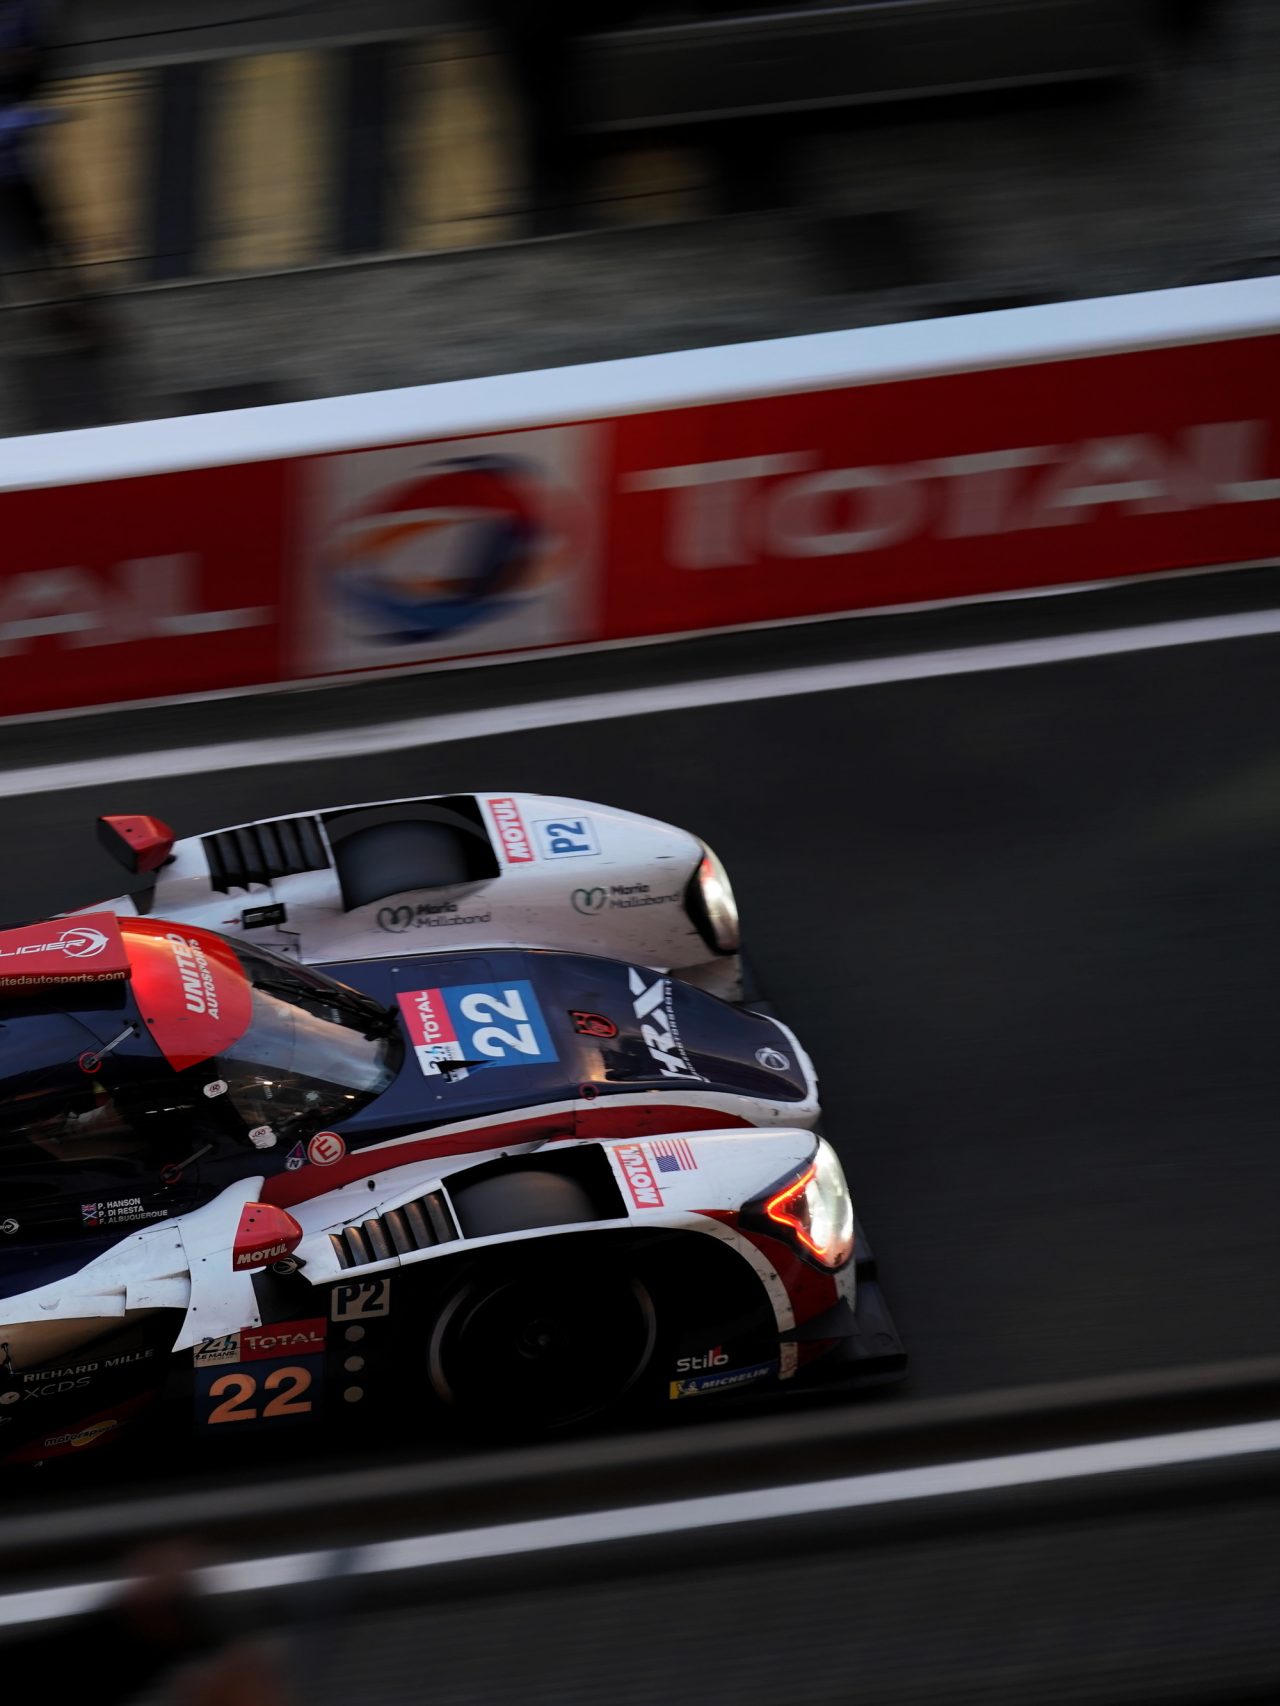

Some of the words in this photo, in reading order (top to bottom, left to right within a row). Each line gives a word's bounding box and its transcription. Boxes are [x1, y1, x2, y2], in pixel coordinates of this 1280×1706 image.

[619, 418, 1280, 570] TOTAL
[491, 799, 531, 862] MOTUL
[544, 821, 589, 854] P2
[165, 933, 206, 1014] UNITED
[188, 938, 219, 1020] AUTOSPORTS
[415, 991, 442, 1043] TOTAL
[459, 989, 541, 1057] 22
[618, 1145, 660, 1206] MOTUL
[107, 1197, 141, 1209] HANSON
[107, 1209, 168, 1224] ALBUQUERQUE
[117, 1205, 145, 1216] RESTA
[237, 1243, 288, 1265] MOTUL
[337, 1279, 384, 1316] P2
[244, 1331, 325, 1351] TOTAL
[23, 1362, 99, 1382] RICHARD
[105, 1349, 154, 1369] MILLE
[676, 1350, 729, 1373] Stilo
[701, 1367, 770, 1389] MICHELIN
[207, 1366, 313, 1424] 22
